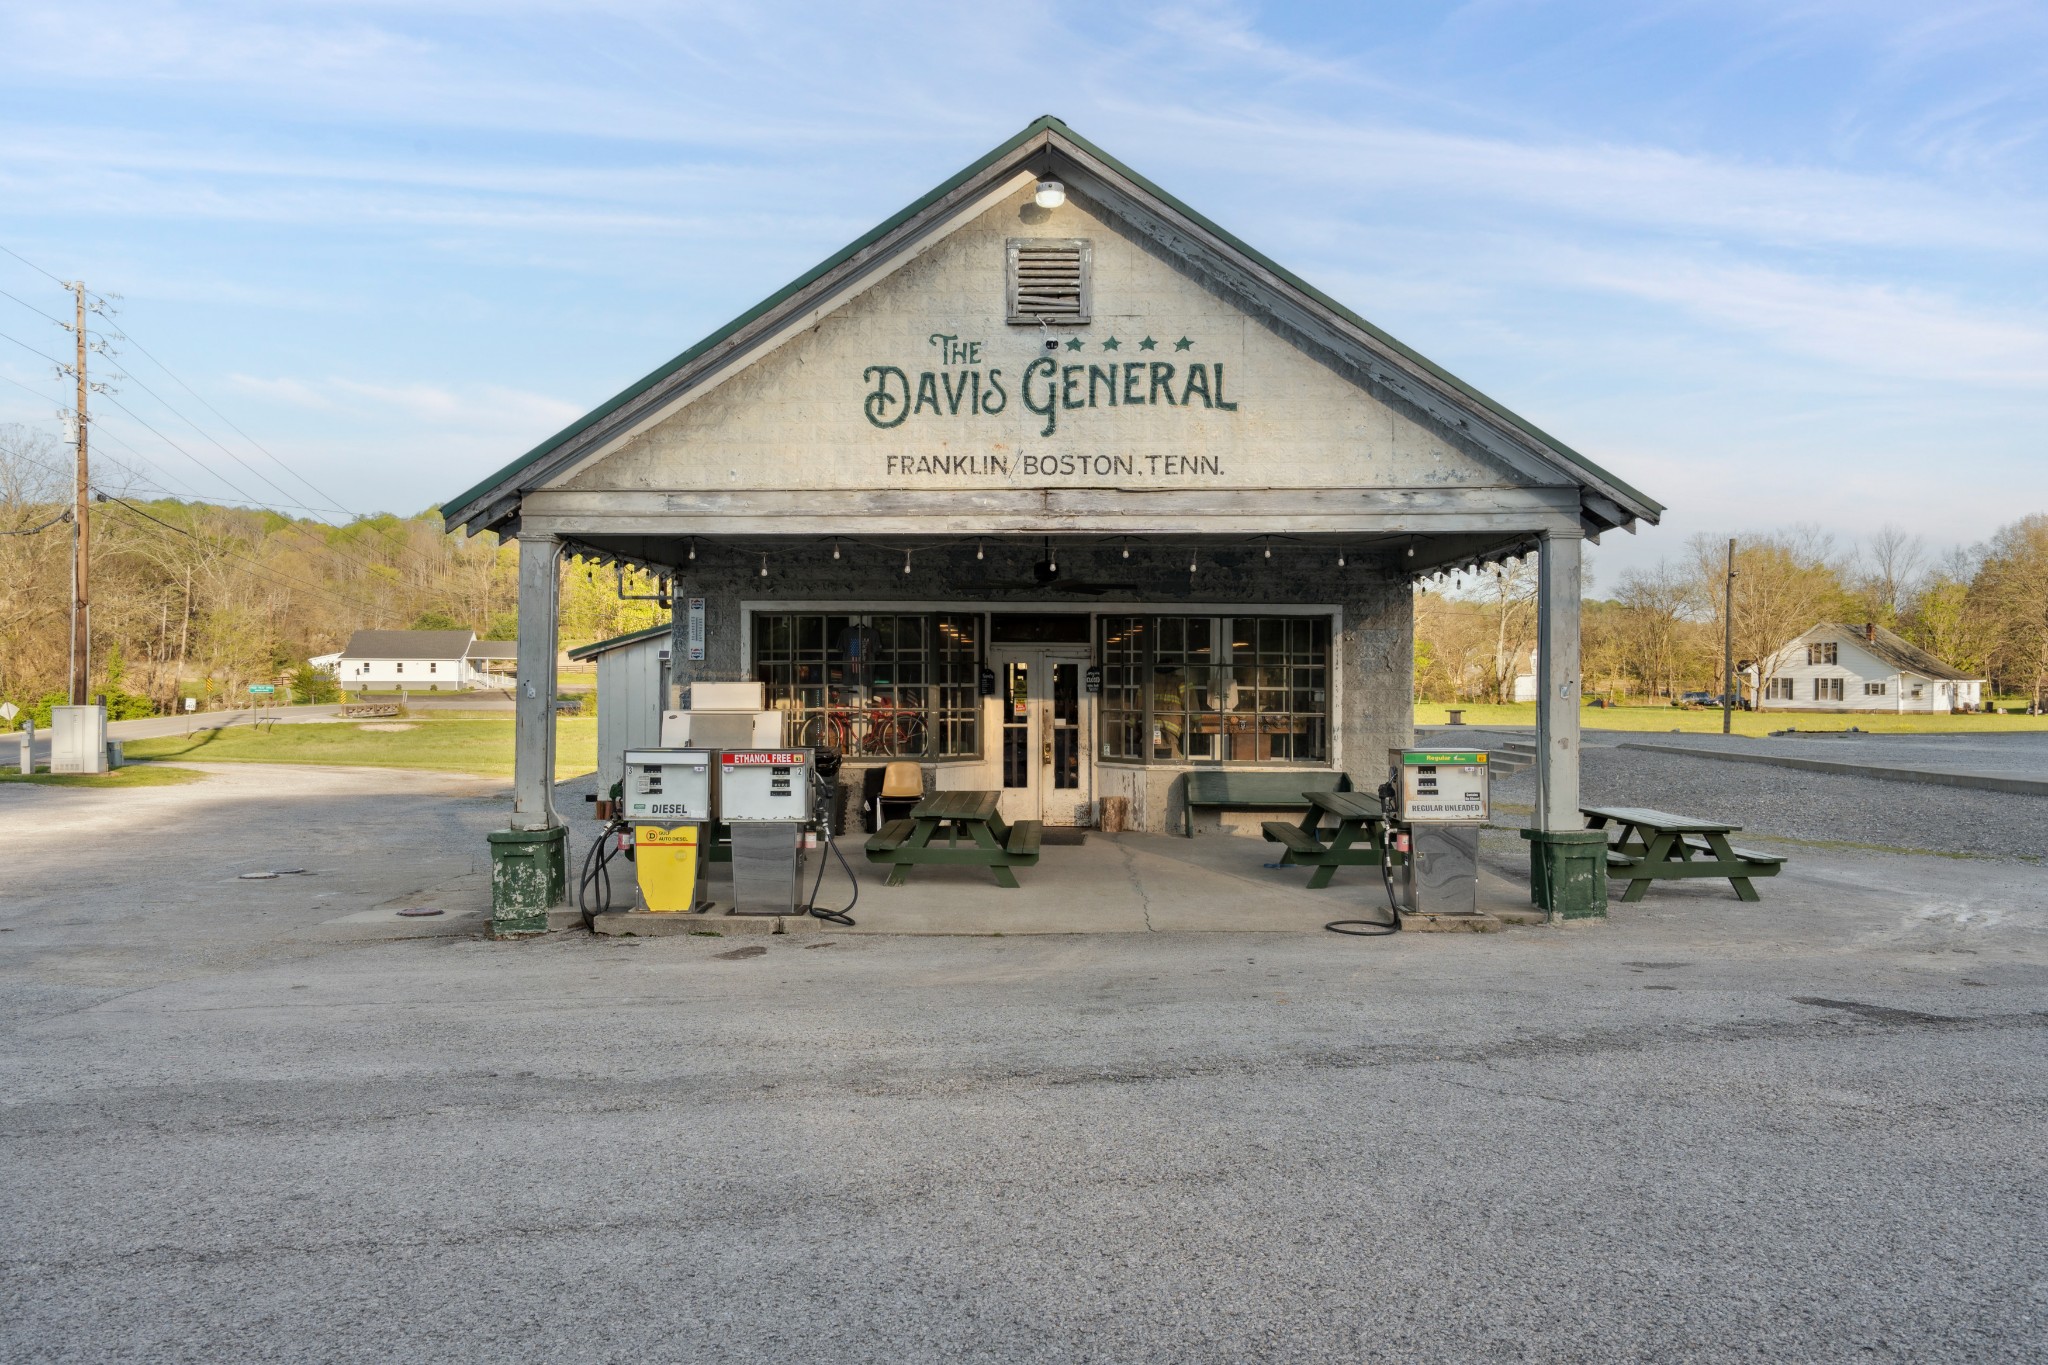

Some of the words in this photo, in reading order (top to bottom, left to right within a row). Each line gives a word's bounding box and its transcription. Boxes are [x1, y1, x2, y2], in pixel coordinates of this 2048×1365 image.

[929, 333, 982, 365] THE
[863, 365, 1007, 429] DAVIS
[1021, 356, 1239, 438] GENERAL
[734, 753, 771, 763] ETHANOL
[772, 753, 792, 763] FREE
[628, 766, 633, 775] 3
[797, 767, 802, 776] 2
[1480, 767, 1483, 775] 1
[652, 804, 688, 814] DIESEL
[1411, 804, 1443, 812] REGULAR
[1444, 804, 1480, 812] UNLEADED
